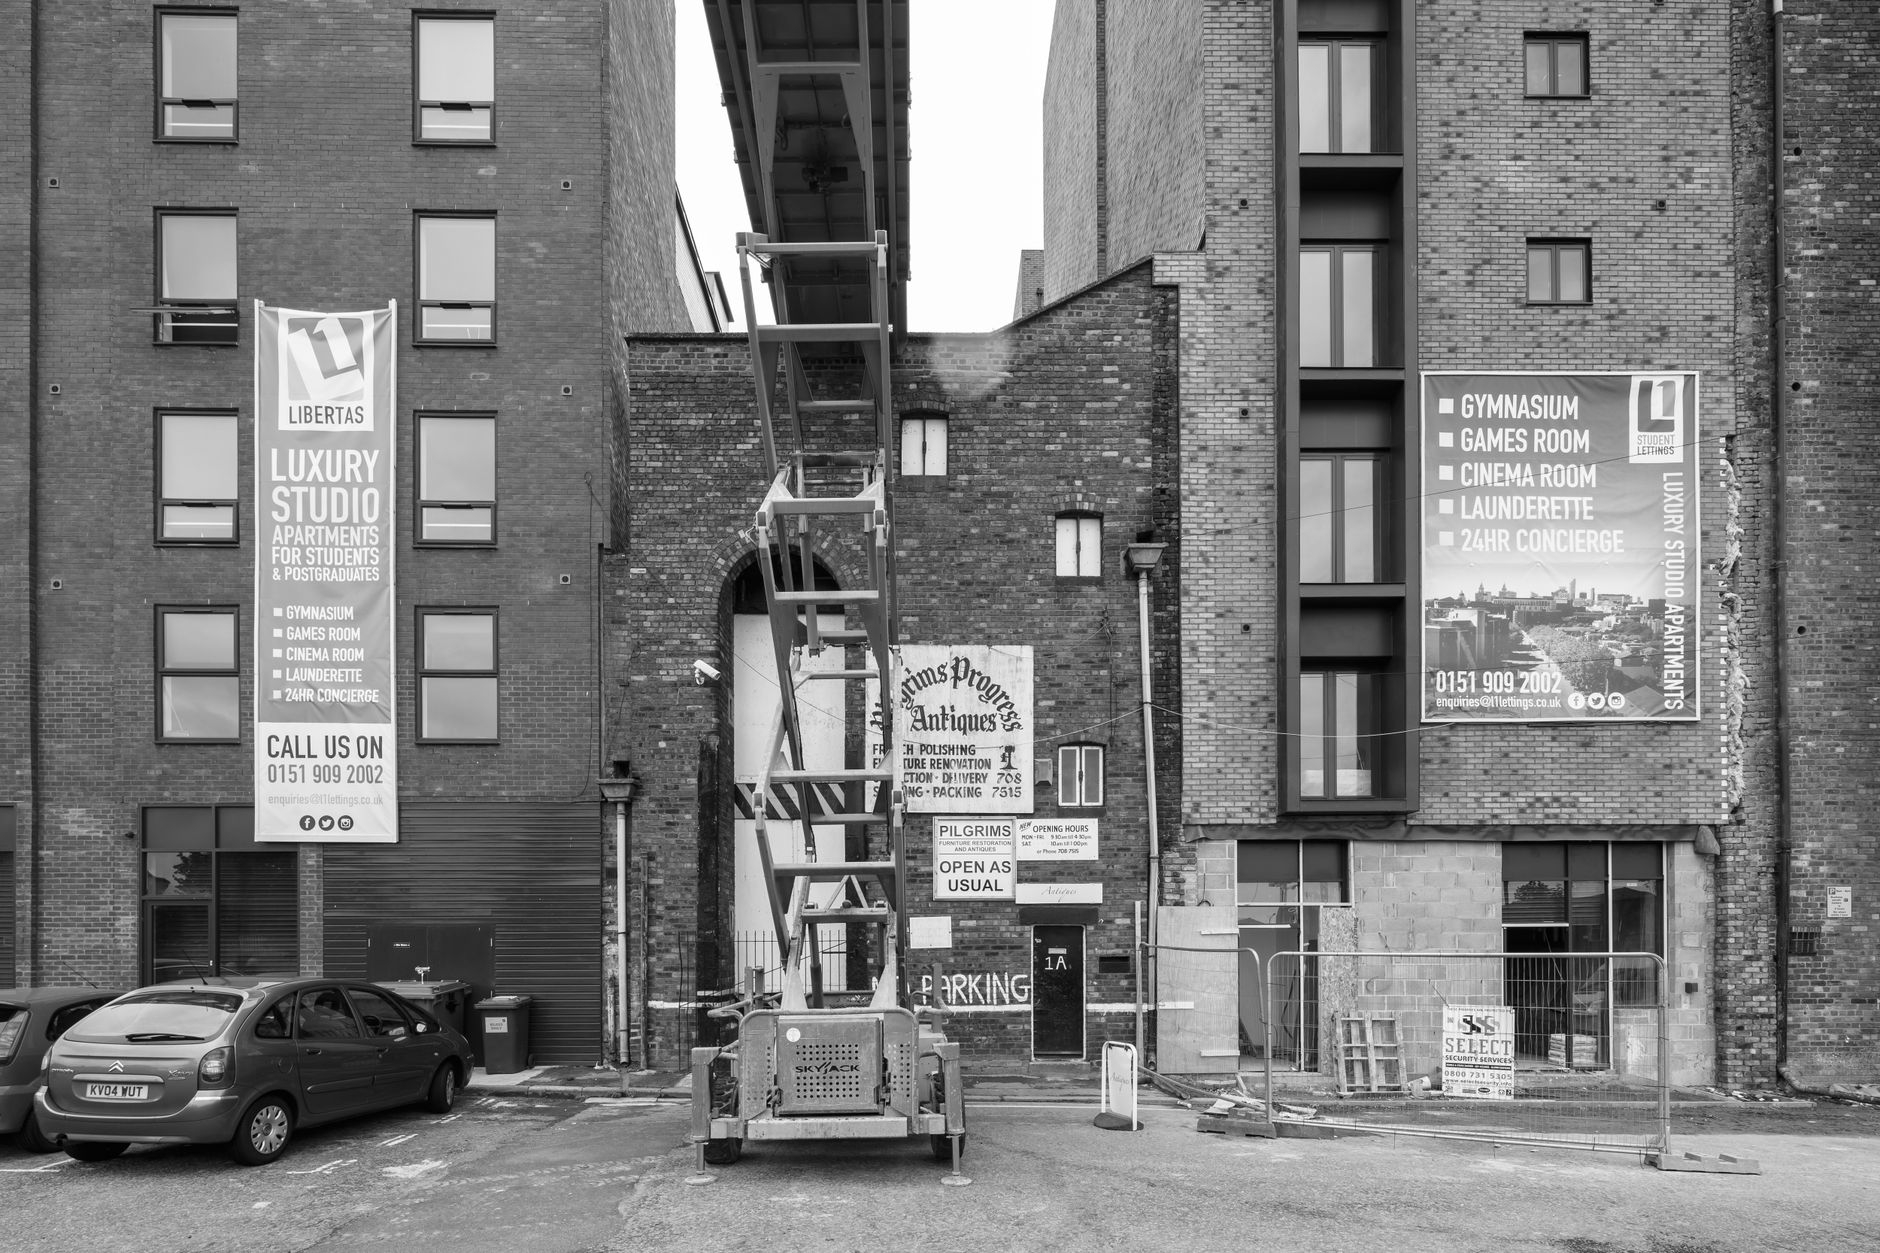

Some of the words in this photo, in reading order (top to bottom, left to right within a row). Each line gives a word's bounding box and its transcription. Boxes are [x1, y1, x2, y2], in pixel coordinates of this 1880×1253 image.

[1461, 393, 1579, 420] GYMNASIUM
[289, 405, 364, 424] LIBERTAS
[1461, 428, 1528, 453] GAMES
[1533, 428, 1590, 453] ROOM
[1637, 435, 1675, 445] STUDENT
[1637, 446, 1675, 456] LETTINGS
[271, 448, 380, 483] LUXURY
[1461, 463, 1535, 487] CINEMA
[1540, 463, 1597, 488] ROOM
[271, 486, 380, 523] STUDIO
[1461, 495, 1594, 520] LAUNDERETTE
[1663, 472, 1684, 535] LUXURY
[272, 525, 379, 546] APARTMENTS
[1461, 528, 1510, 551] 24HR
[1516, 529, 1624, 553] CONCIERGE
[272, 546, 301, 565] FOR
[306, 547, 379, 566] STUDENTS
[272, 567, 281, 581] &
[285, 566, 379, 581] POSTGRADUATES
[1664, 540, 1685, 598] STUDIO
[286, 605, 354, 620] GYMNASIUM
[286, 626, 325, 641] GAMES
[328, 627, 361, 641] ROOM
[286, 647, 329, 661] CINEMA
[333, 648, 364, 661] ROOM
[1664, 603, 1685, 710] APARTMENTS
[285, 668, 362, 682] LAUNDERETTE
[1436, 671, 1476, 694] 0151
[1482, 671, 1514, 694] 909
[1519, 671, 1561, 694] 2002
[285, 688, 314, 702] 24HR
[317, 689, 379, 703] CONCIERGE
[950, 656, 1023, 732] Progress
[910, 704, 997, 736] Antiques
[267, 735, 317, 759] CALL
[324, 735, 350, 759] US
[357, 735, 383, 759] ON
[920, 744, 976, 755] POLISHING
[930, 758, 991, 770] RENOVATION
[268, 764, 305, 783] 0151
[313, 764, 341, 783] 909
[347, 764, 383, 784] 2002
[997, 773, 1022, 784] 708
[933, 787, 982, 798] PACKING
[992, 787, 1021, 798] 7515
[940, 825, 1011, 837] PILGRIMS
[1019, 821, 1032, 830] NEW
[1033, 825, 1063, 833] OPENING
[1065, 825, 1089, 833] HOURS
[940, 861, 984, 873] OPEN
[989, 861, 1011, 873] AS
[948, 879, 1004, 892] USUAL
[1045, 956, 1067, 970] 1A
[1445, 1037, 1512, 1056] SELECT
[795, 1061, 859, 1074] SKYJACK
[1480, 1056, 1512, 1064] SERVICES
[1470, 1071, 1485, 1079] 731
[1490, 1072, 1512, 1080] 5305
[90, 1084, 117, 1097] KV04
[121, 1085, 143, 1097] WUT
